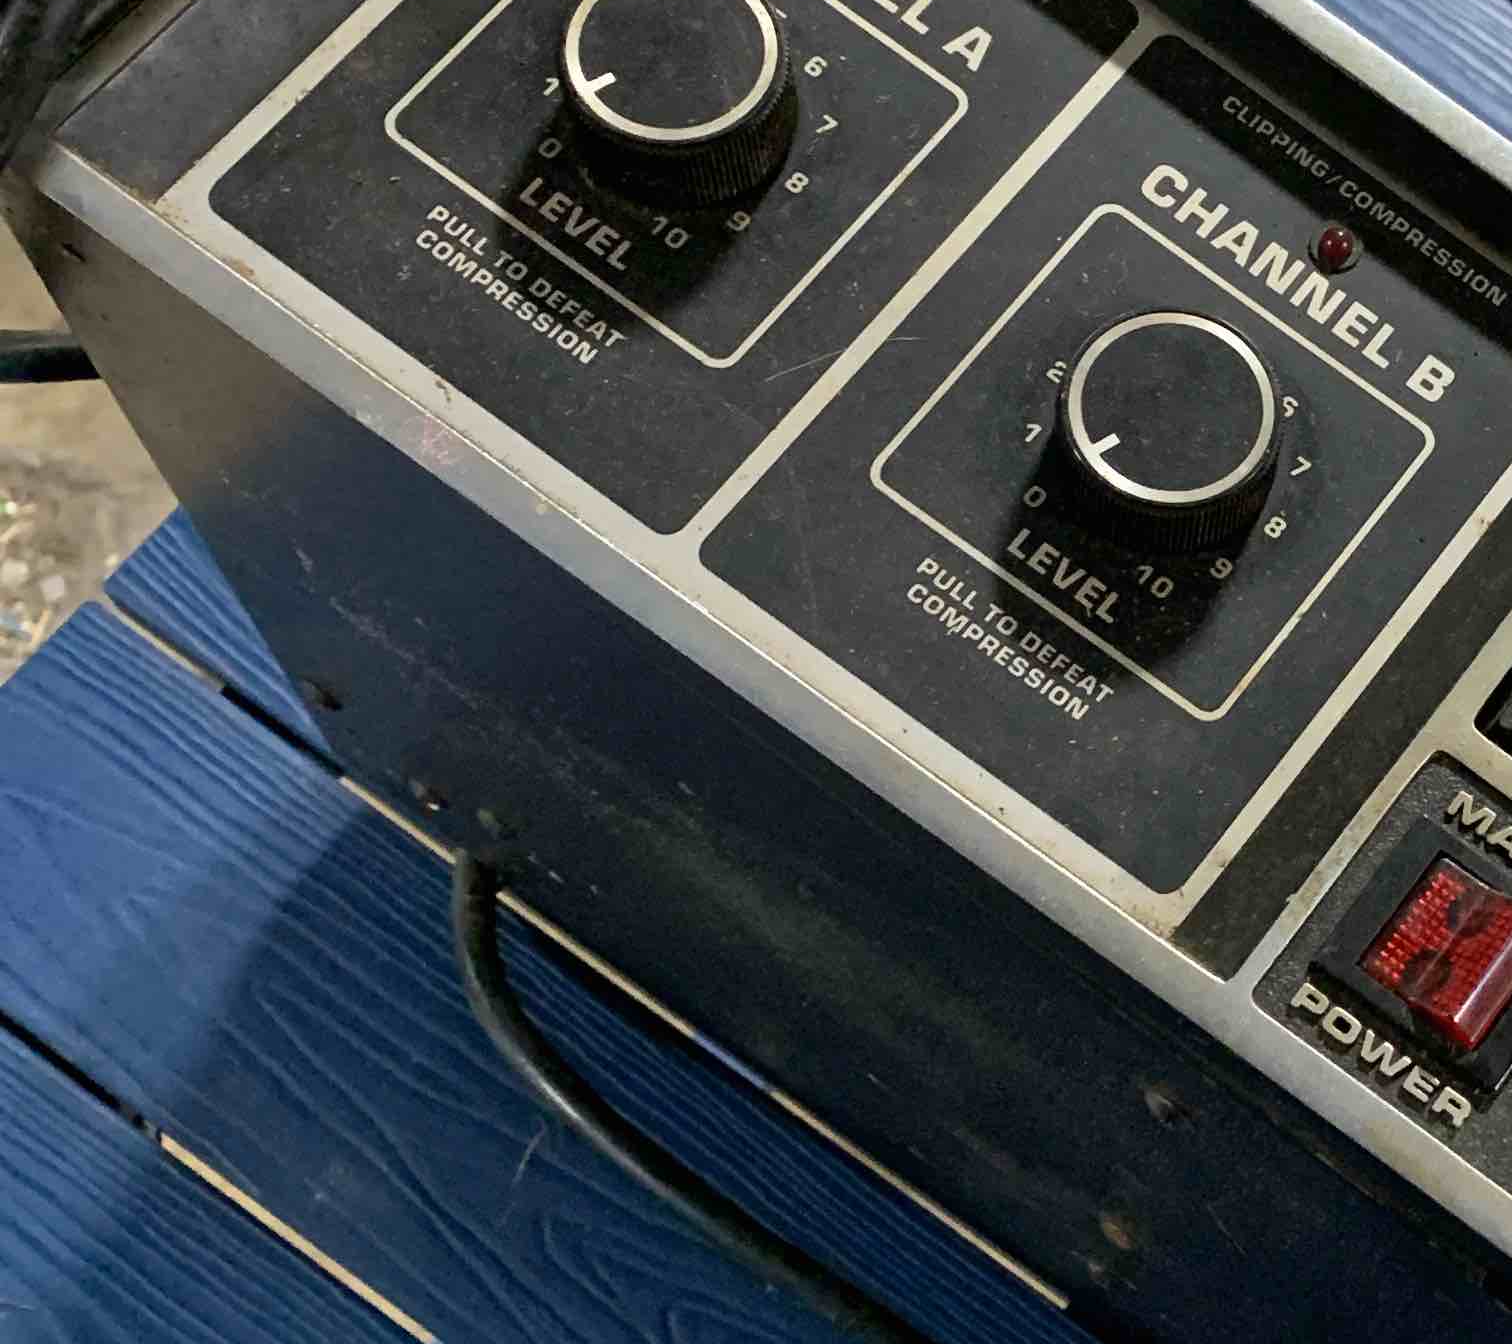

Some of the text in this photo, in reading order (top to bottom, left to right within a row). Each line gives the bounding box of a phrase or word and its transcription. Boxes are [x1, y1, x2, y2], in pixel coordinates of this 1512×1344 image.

[942, 26, 994, 72] A
[803, 56, 826, 78] 6
[543, 78, 559, 96] 1
[817, 116, 839, 136] 7
[539, 137, 563, 158] 0
[784, 172, 808, 194] 8
[1222, 95, 1508, 307] CLIPPING/COMPRESSION
[519, 177, 633, 271] LEVEL
[649, 215, 692, 250] 10
[727, 211, 750, 232] 9
[426, 204, 625, 348] PULL TO DEFEAT
[1140, 163, 1456, 404] CHANNEL B
[415, 230, 599, 365] COMPRESSION
[1045, 361, 1067, 384] 2
[1024, 423, 1041, 442] 1
[1290, 457, 1312, 477] 7
[1023, 486, 1046, 509] 0
[1264, 516, 1287, 539] 8
[1007, 528, 1123, 624] LEVEL
[1134, 564, 1175, 600] 10
[1210, 557, 1233, 580] 9
[916, 558, 1114, 705] PULL TO DEFEAT
[907, 583, 1091, 721] COMPRESSION
[1291, 981, 1474, 1130] POWER
